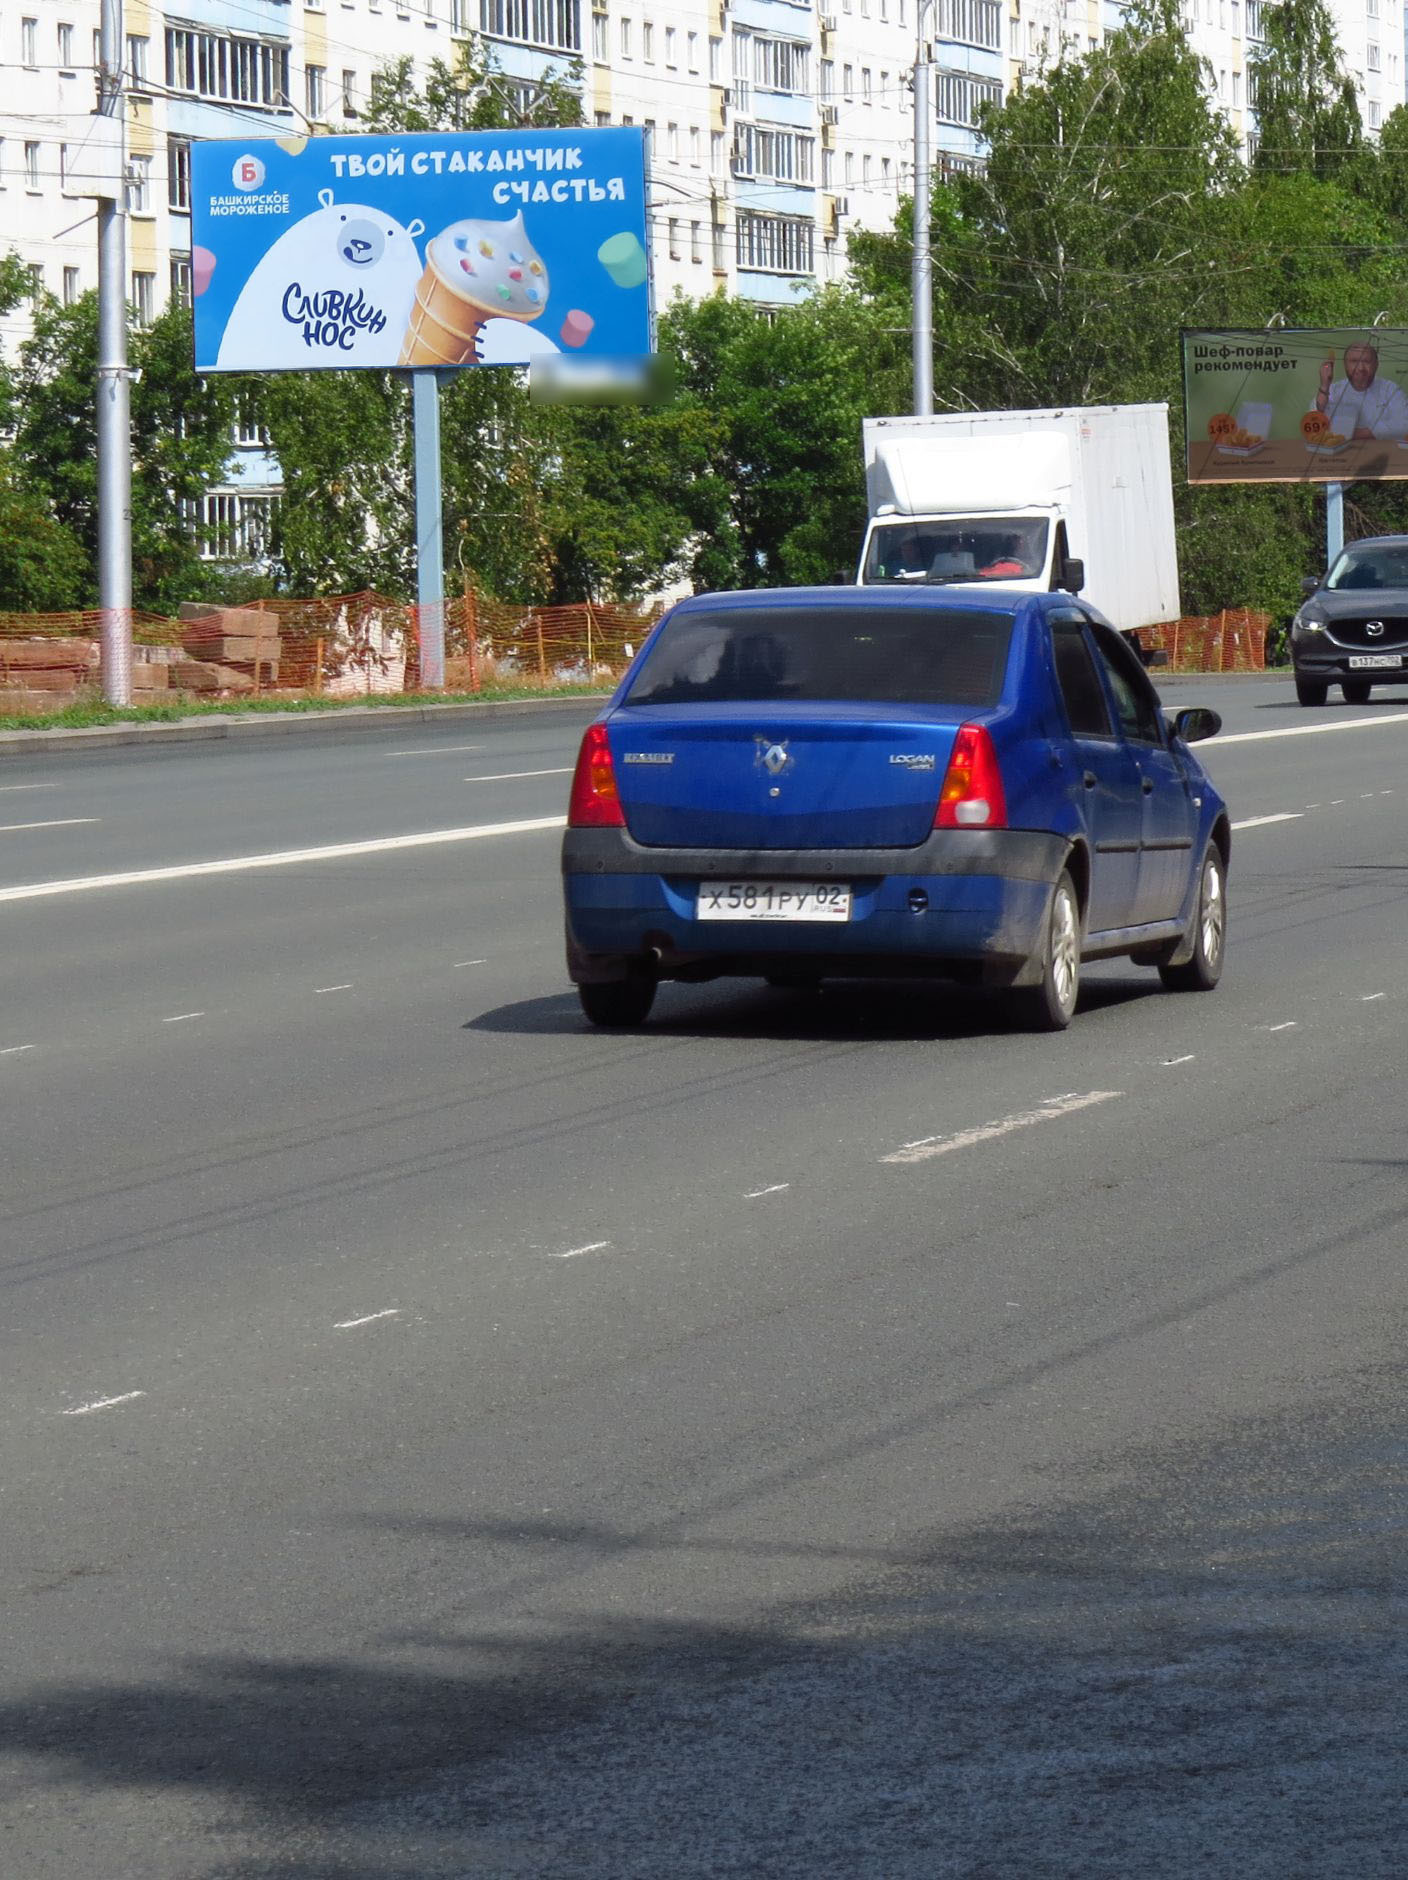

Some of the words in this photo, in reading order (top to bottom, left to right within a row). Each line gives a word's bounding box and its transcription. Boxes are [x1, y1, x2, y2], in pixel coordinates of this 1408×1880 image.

[330, 148, 405, 177] ТВОЙ
[411, 147, 583, 175] СТАКАНЧИК
[242, 163, 256, 182] Б
[492, 177, 625, 204] СЧАСТЬЯ
[210, 193, 289, 206] БАШКИРСКОЕ
[210, 204, 290, 216] МОРОЖЕНОЕ
[1194, 345, 1284, 359] Шеф-повар
[1194, 359, 1298, 374] рекомендует
[889, 754, 935, 764] LOGAN
[708, 885, 810, 911] Х581РУ
[815, 886, 840, 905] 02
